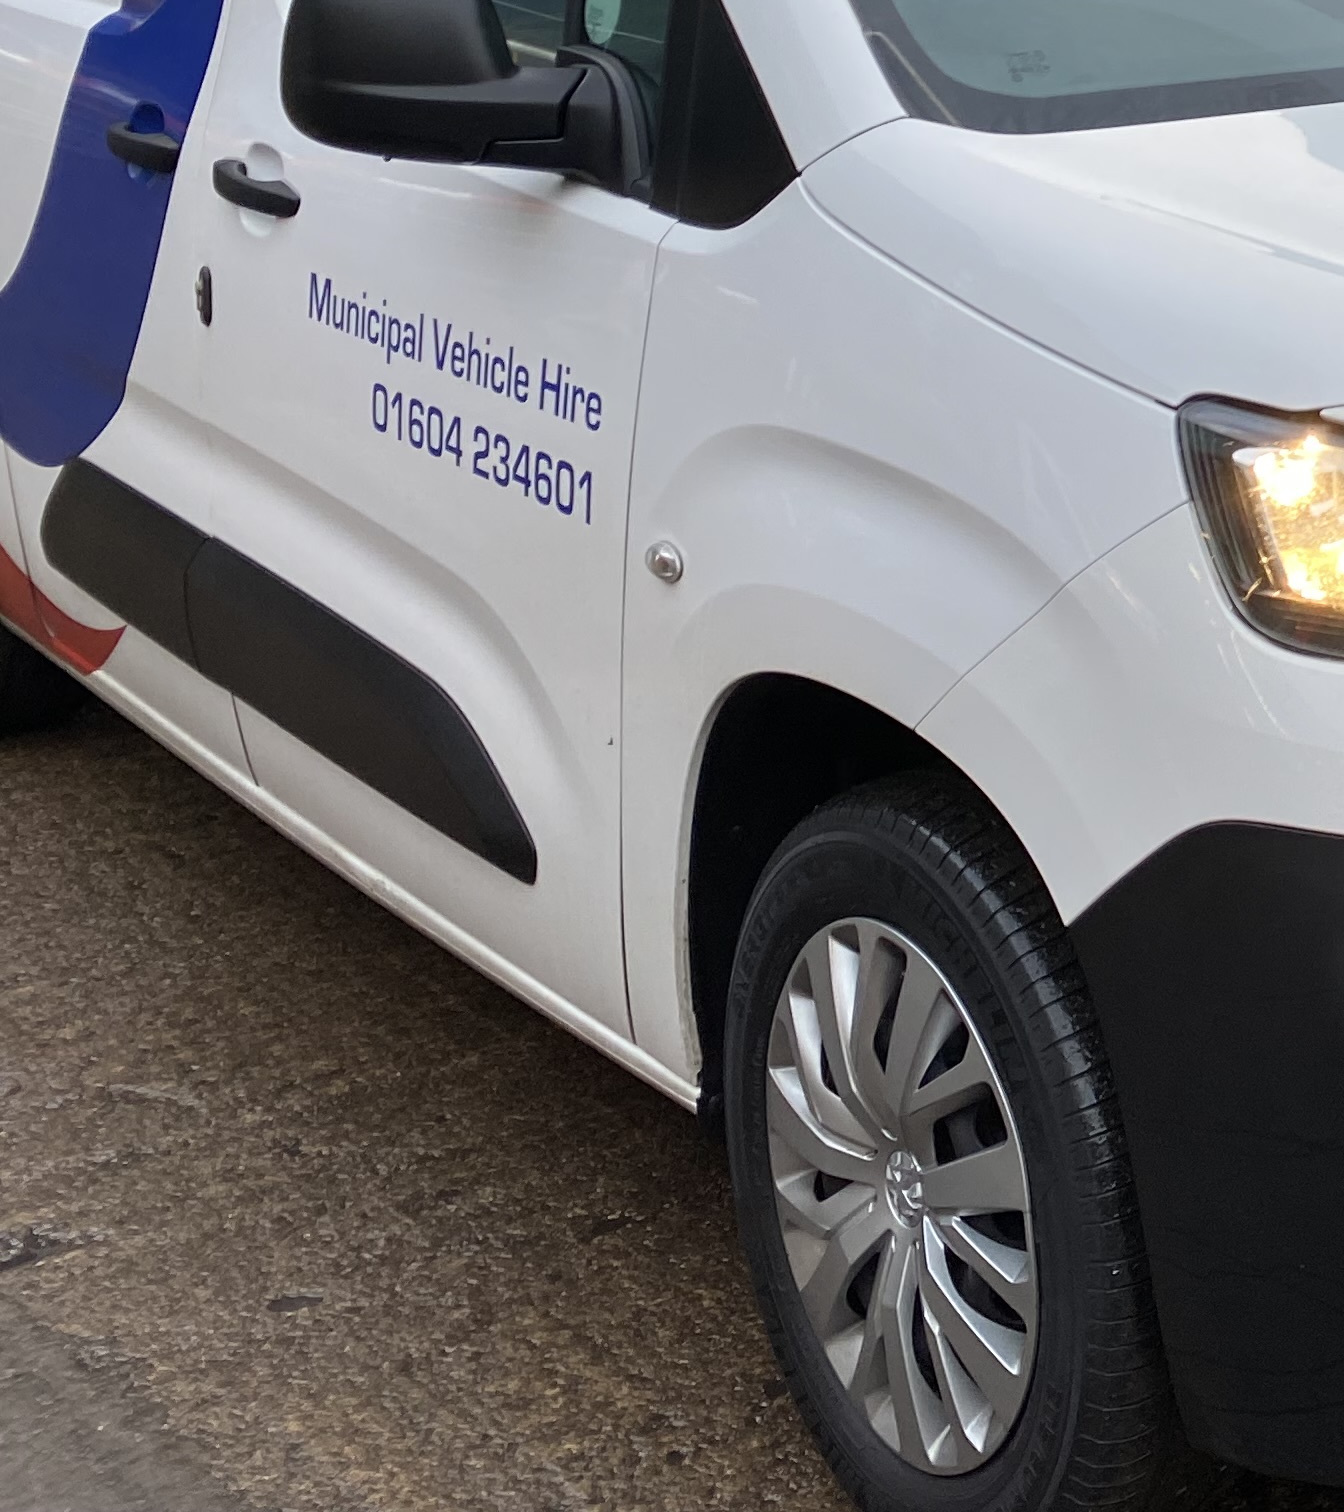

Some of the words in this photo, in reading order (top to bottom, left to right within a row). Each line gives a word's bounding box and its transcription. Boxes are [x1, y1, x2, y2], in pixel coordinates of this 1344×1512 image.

[308, 271, 425, 365] Municipal
[432, 317, 530, 404] Vehicle
[538, 357, 602, 432] Hire
[371, 382, 463, 468] 01604
[472, 424, 593, 526] 234601
